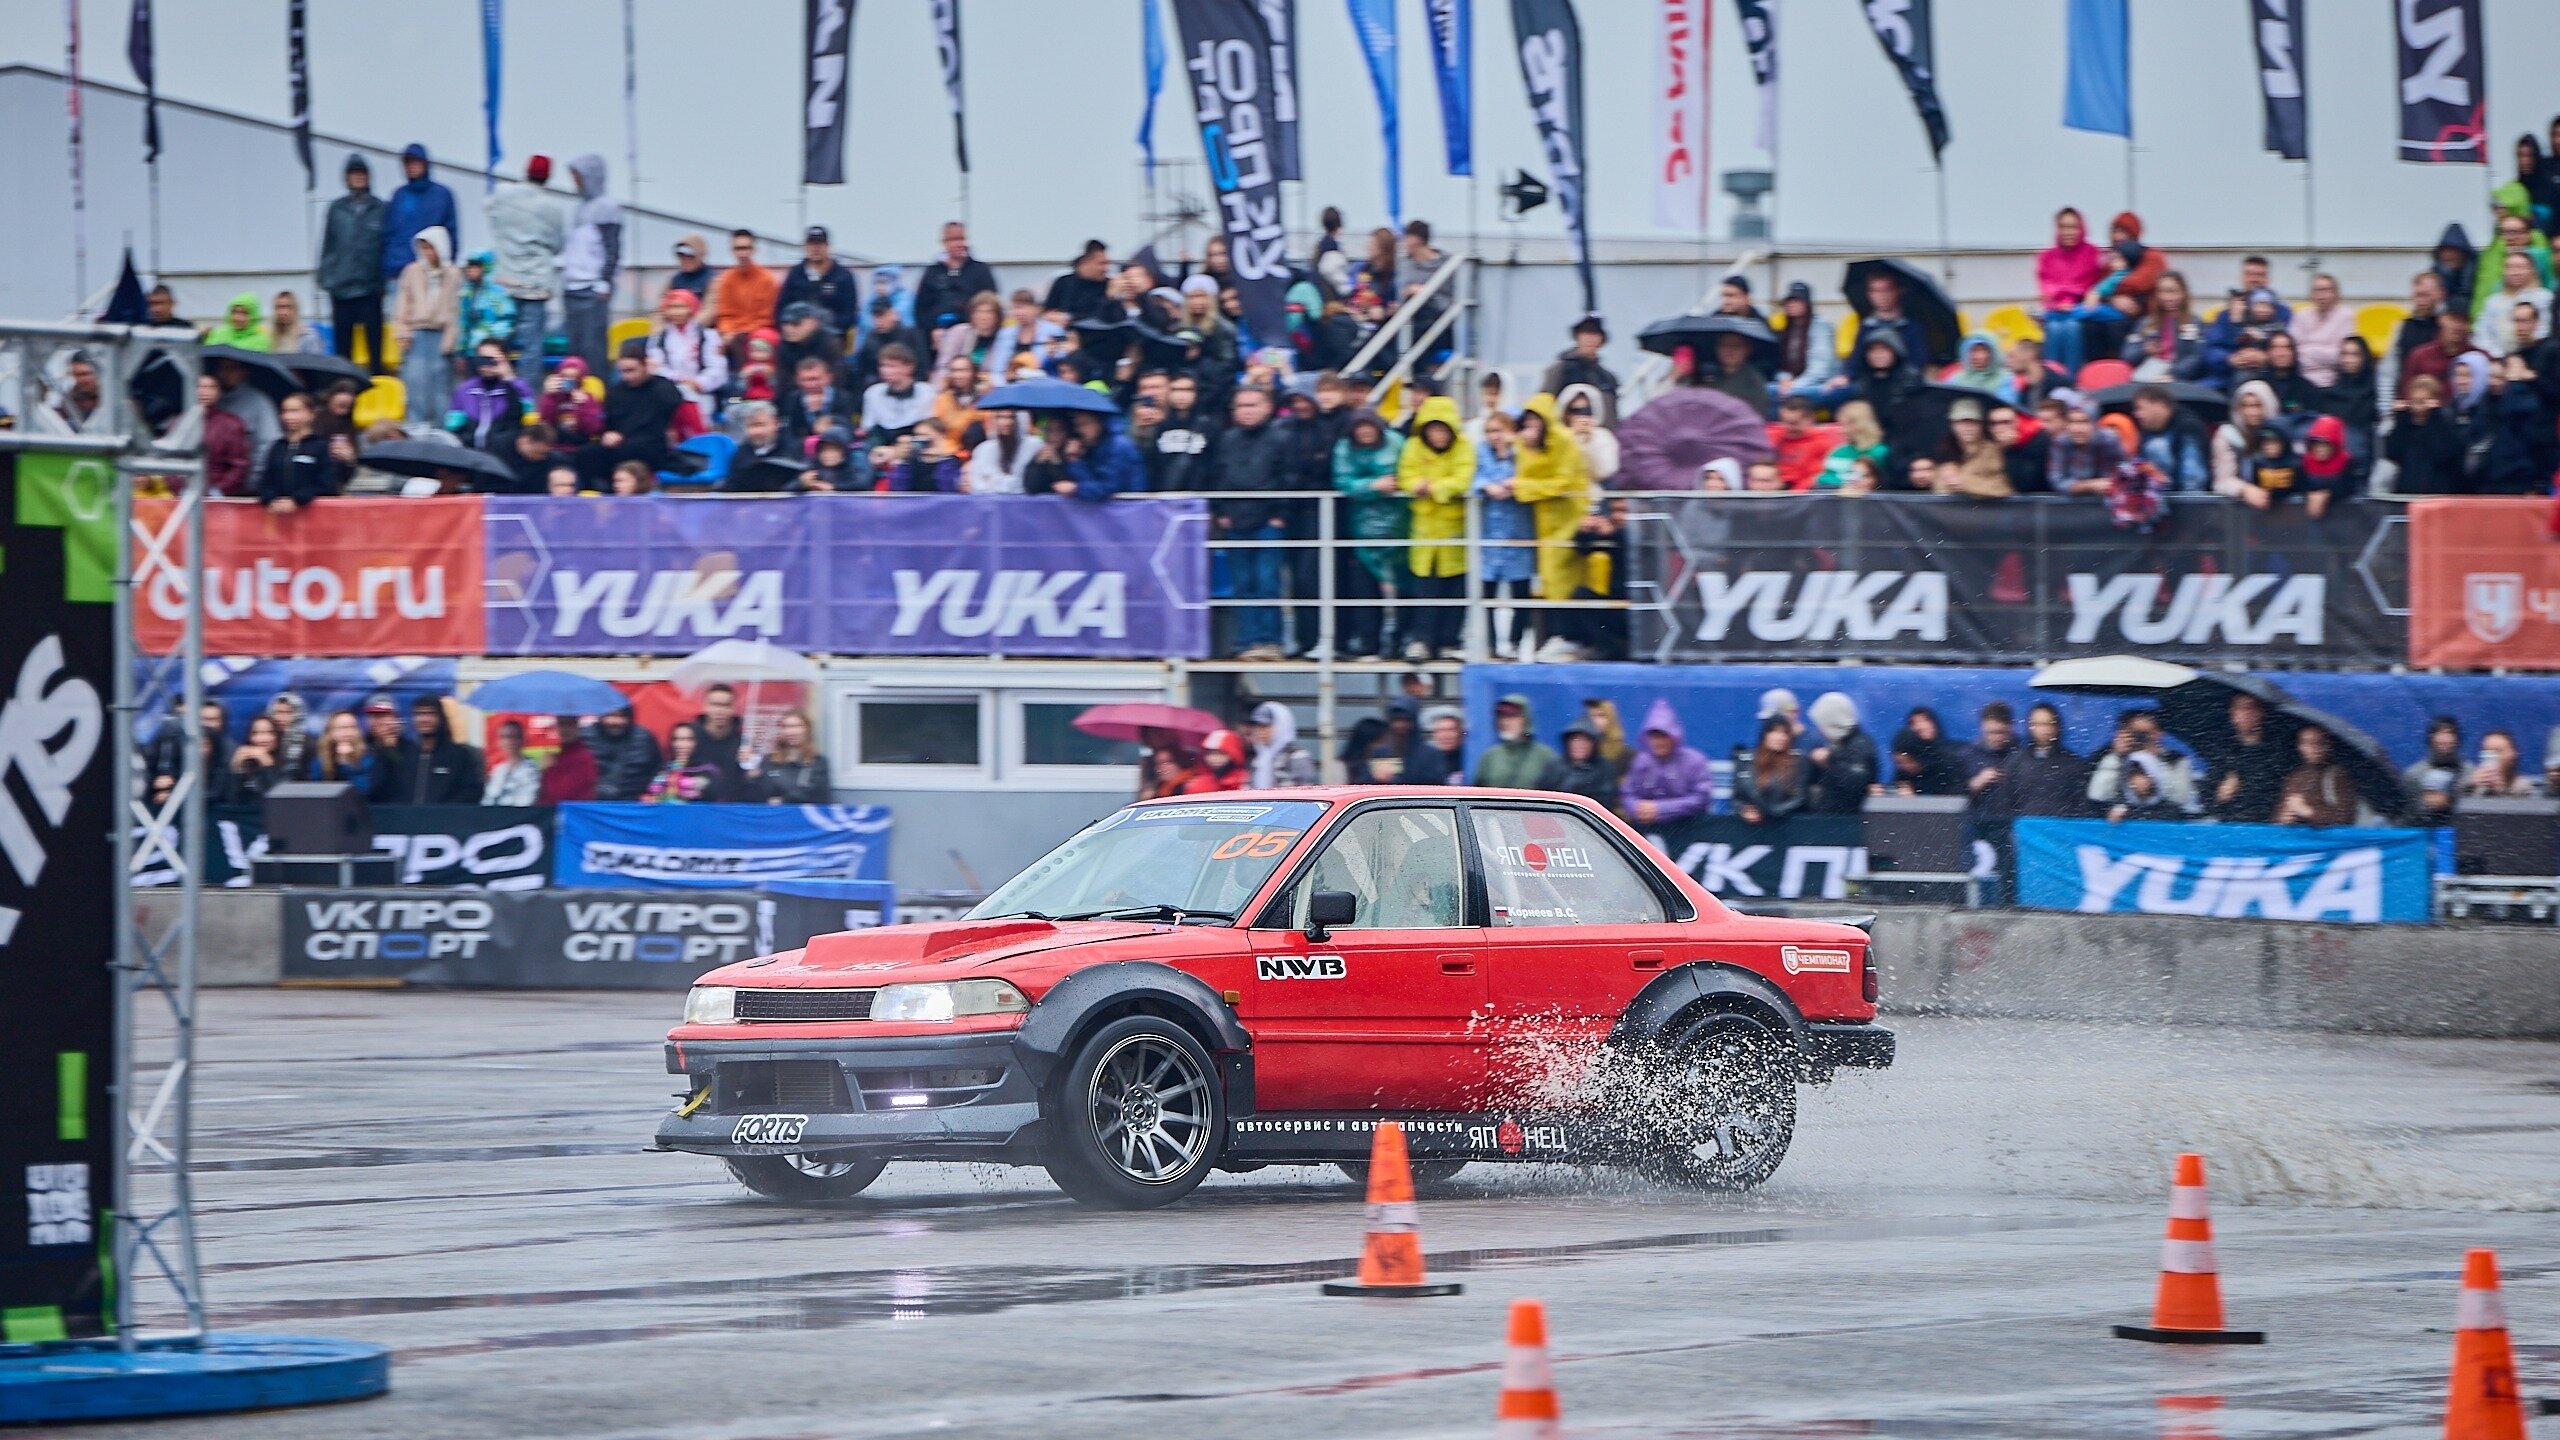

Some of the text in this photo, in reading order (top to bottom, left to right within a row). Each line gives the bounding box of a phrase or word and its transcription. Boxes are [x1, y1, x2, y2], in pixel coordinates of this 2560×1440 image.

[148, 557, 446, 621] auto.ru
[551, 570, 783, 637] YUKA
[891, 570, 1127, 638] YUKA
[1695, 571, 1948, 642] YUKA
[2066, 573, 2325, 645] YUKA
[1212, 831, 1299, 860] 05
[2075, 844, 2383, 923] YUKA
[305, 901, 494, 930] VK ПРО
[563, 902, 634, 932] VK
[635, 902, 750, 932] ПРО
[1508, 906, 1578, 918] Корнеев В.С.
[304, 931, 491, 961] СПОРТ
[563, 933, 750, 962] СПОРТ
[1798, 954, 1847, 966] ЧЕМПИОНАТ
[1259, 959, 1344, 977] NWB
[733, 1115, 807, 1142] FORTIS
[1236, 1120, 1331, 1134] автосервис
[1336, 1121, 1345, 1132] и
